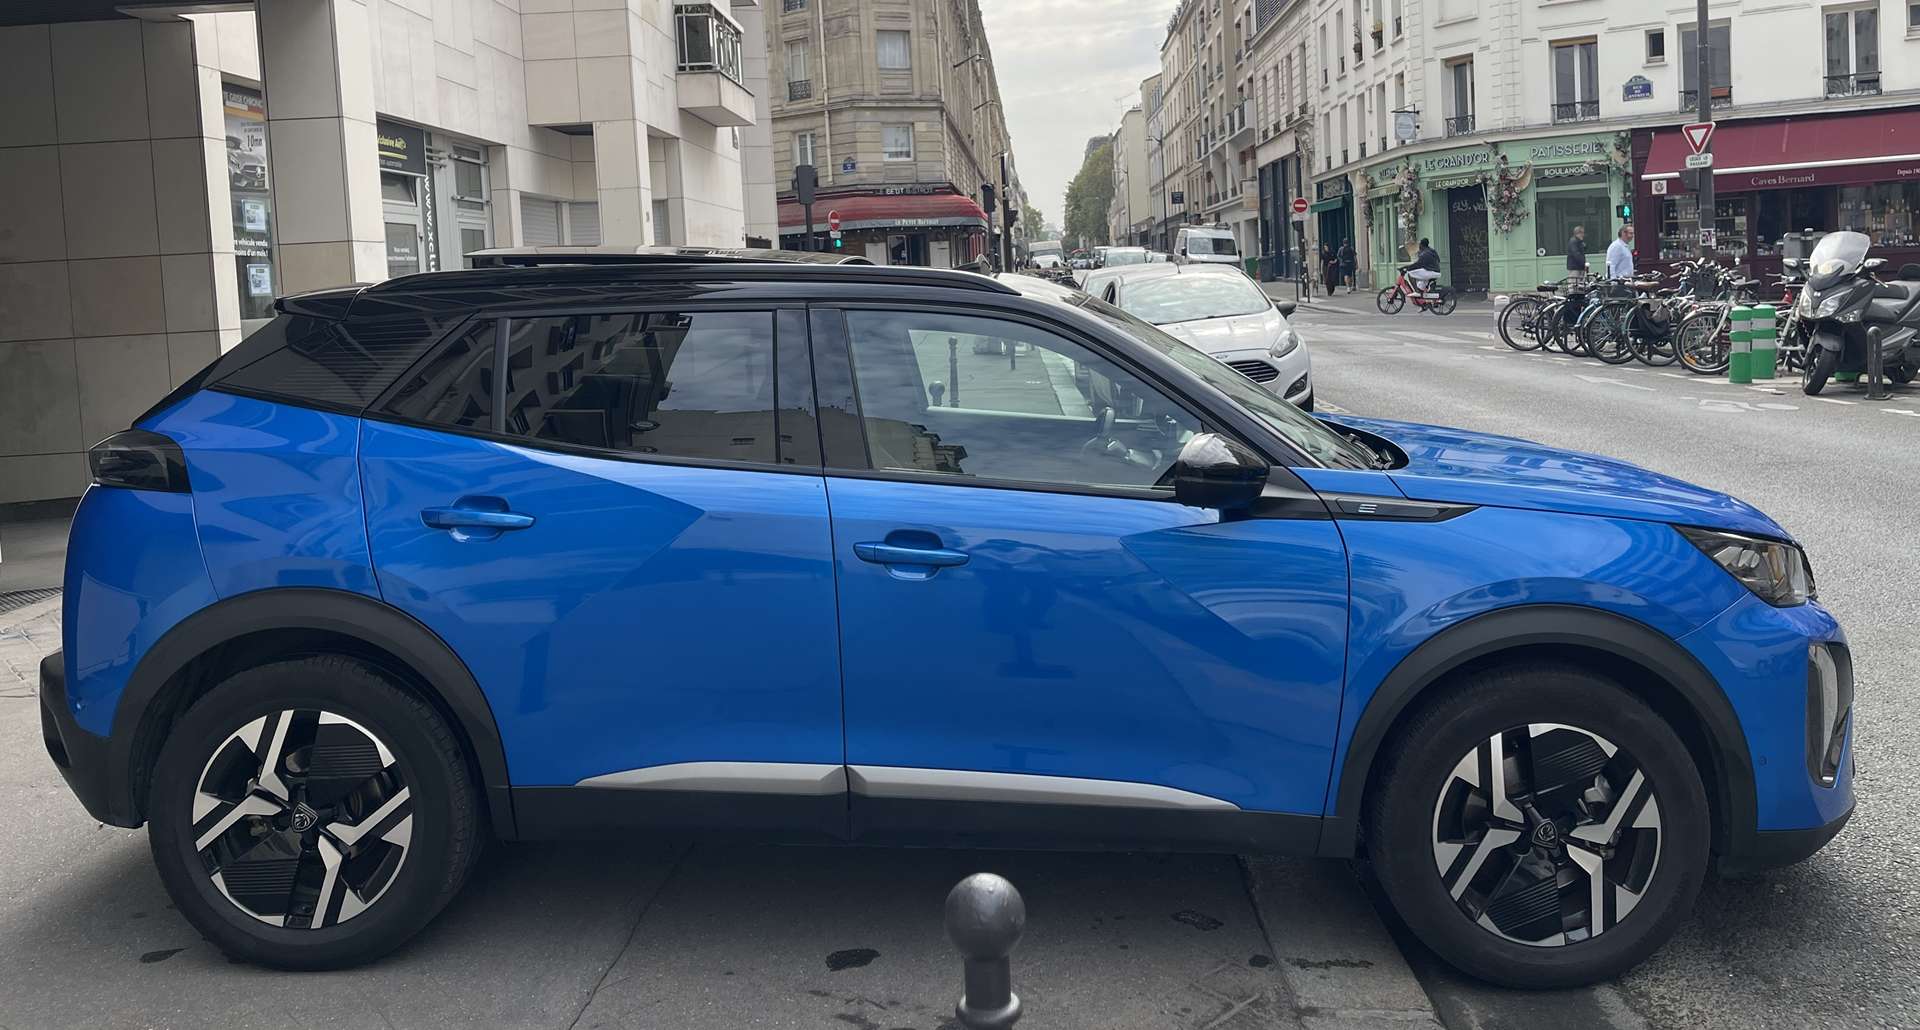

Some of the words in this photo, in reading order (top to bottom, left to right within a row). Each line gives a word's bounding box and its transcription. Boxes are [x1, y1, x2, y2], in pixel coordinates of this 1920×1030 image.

[1530, 142, 1602, 158] PATISSERIE
[1425, 159, 1436, 171] LE
[1751, 176, 1777, 186] Caves
[1778, 173, 1816, 185] Bernard
